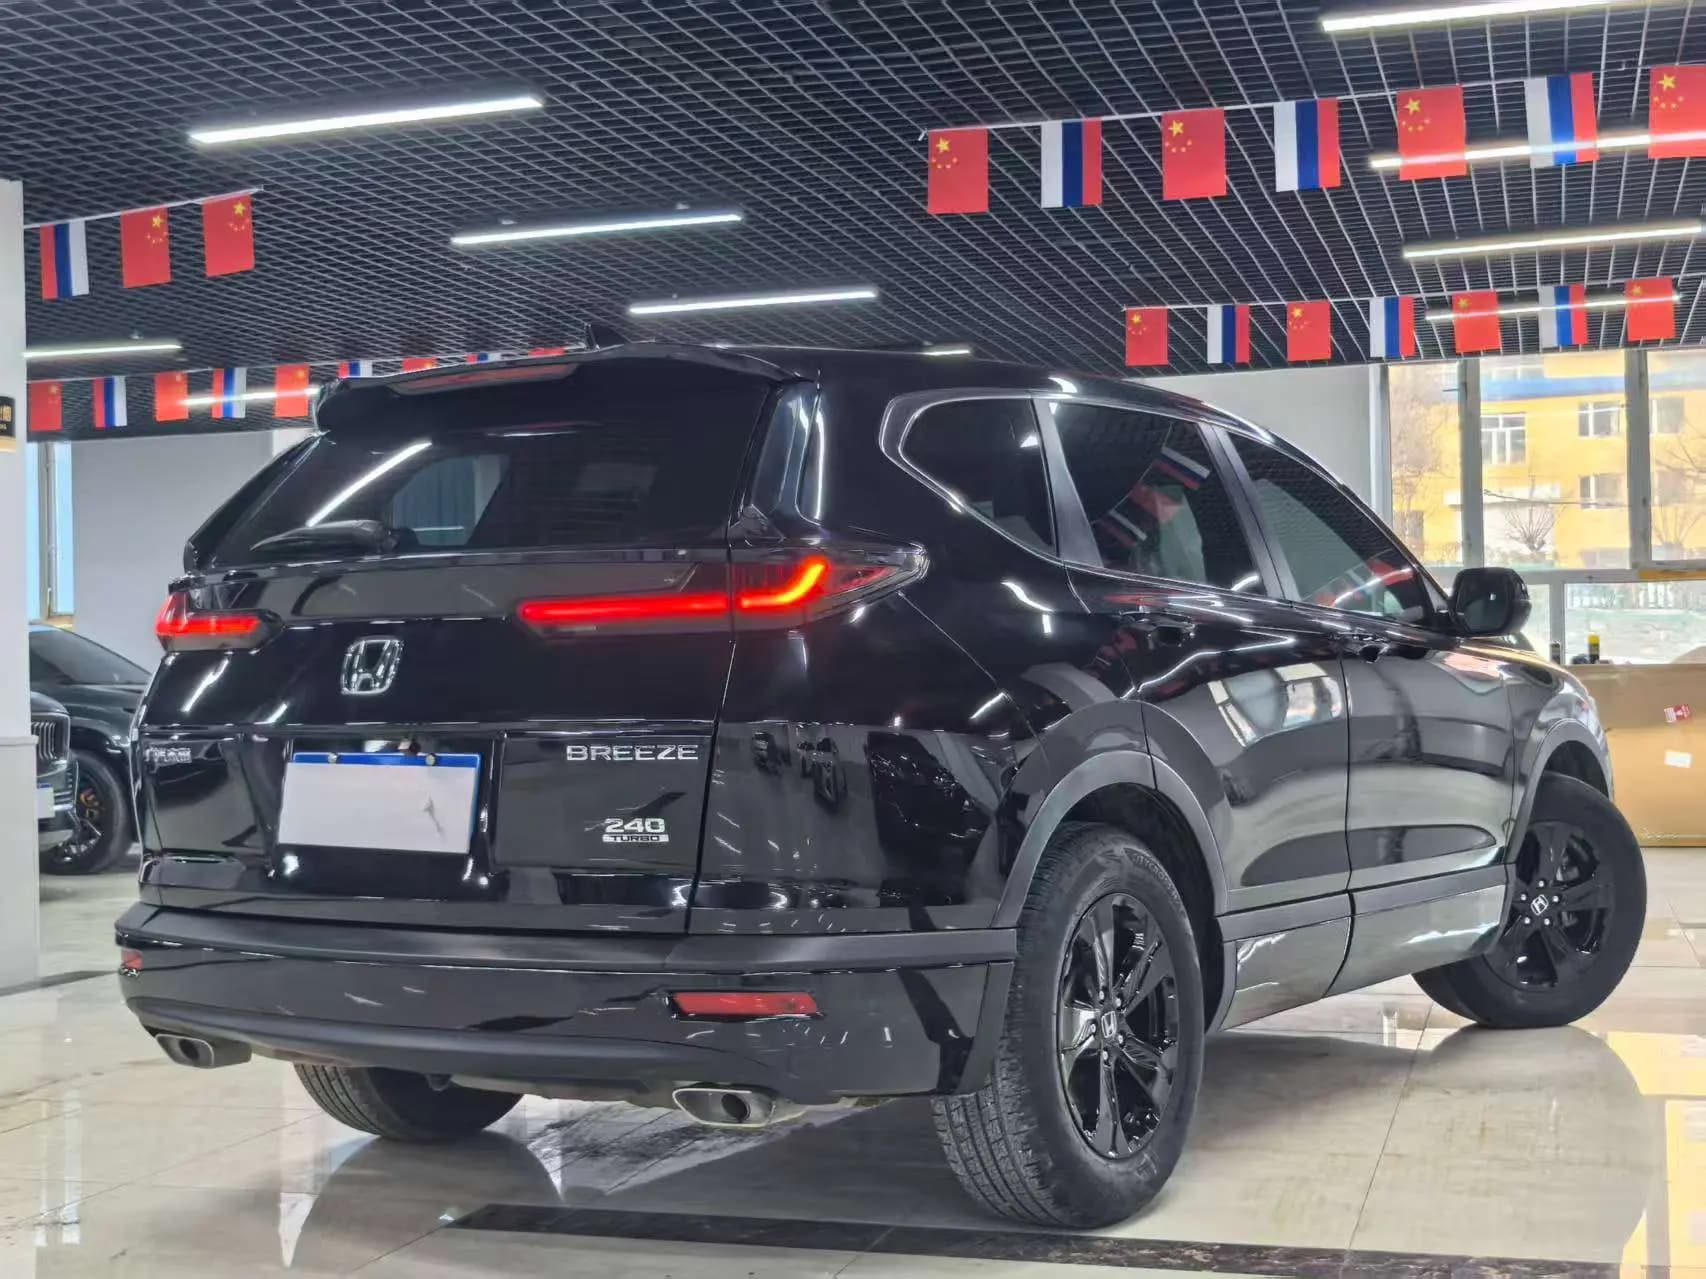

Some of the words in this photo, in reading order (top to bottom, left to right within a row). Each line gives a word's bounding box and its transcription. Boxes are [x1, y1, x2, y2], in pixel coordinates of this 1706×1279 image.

[566, 744, 698, 761] BREEZE
[604, 817, 666, 833] 240
[606, 834, 663, 842] TURBO
